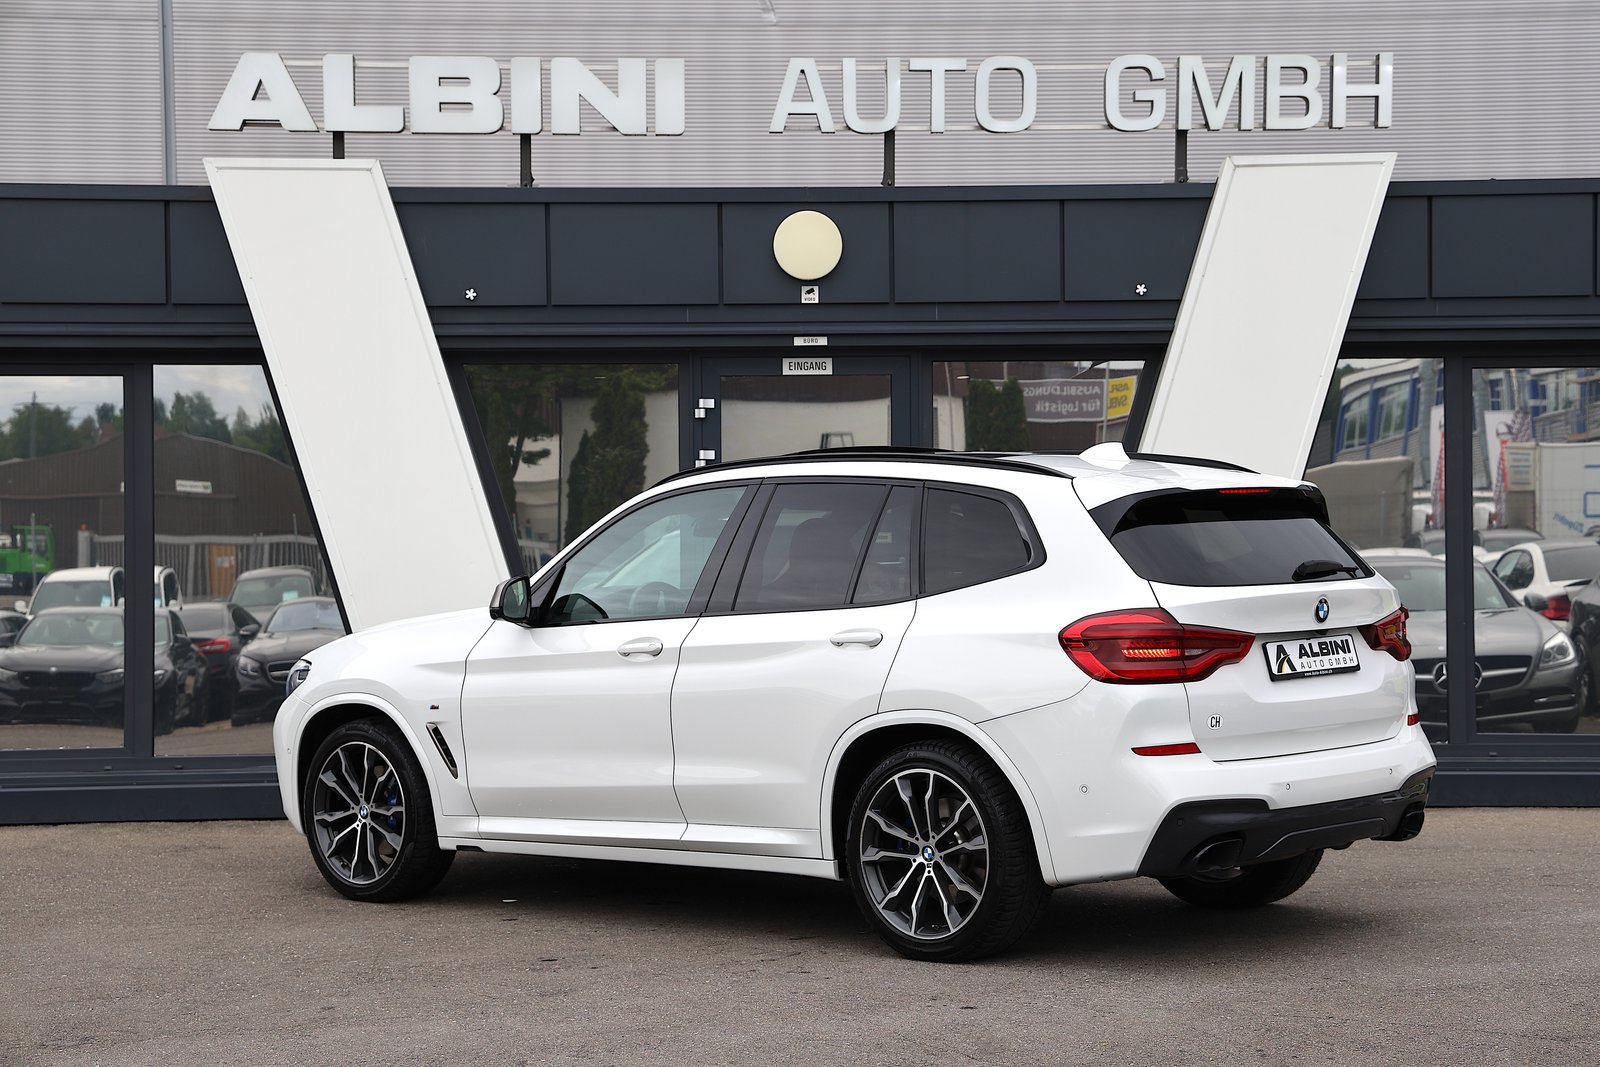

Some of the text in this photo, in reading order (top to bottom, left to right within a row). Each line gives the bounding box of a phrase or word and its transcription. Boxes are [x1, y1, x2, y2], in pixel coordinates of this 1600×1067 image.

[207, 51, 1394, 136] ALBINI AUTO GMBH
[788, 361, 827, 371] EINGANG
[1298, 639, 1352, 660] ALBINI
[1300, 656, 1355, 669] AUTO GMBH
[1210, 716, 1221, 728] CH
